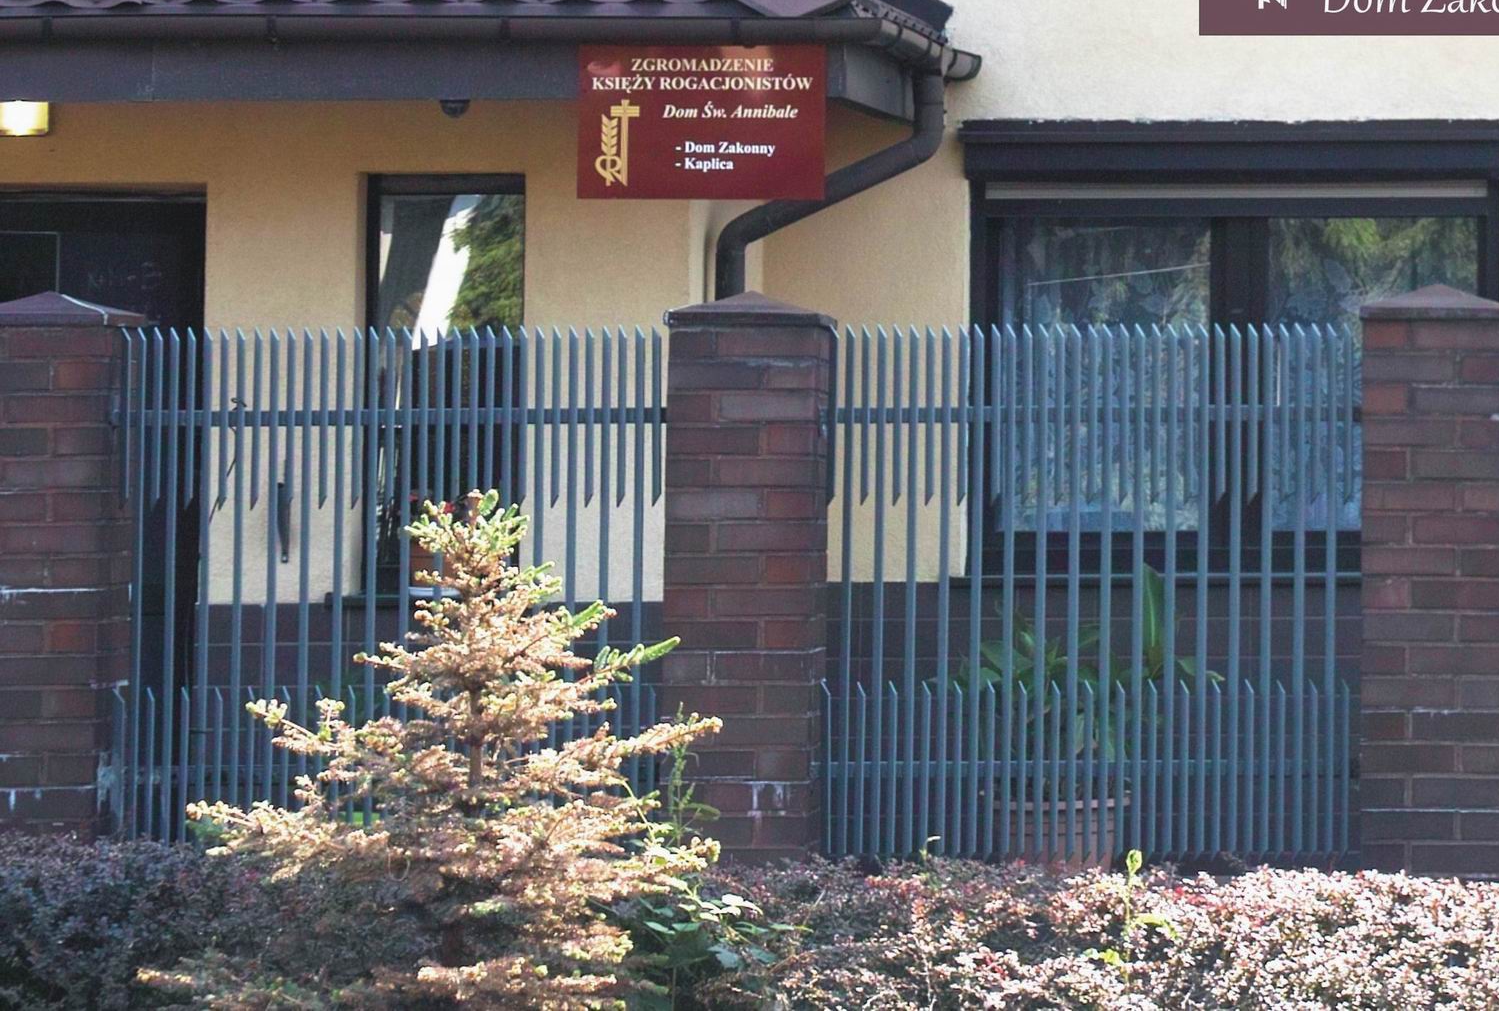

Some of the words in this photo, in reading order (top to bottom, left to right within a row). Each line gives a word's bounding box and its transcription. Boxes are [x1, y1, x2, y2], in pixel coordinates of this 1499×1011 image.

[631, 58, 774, 72] ZGROMADZENIE
[592, 75, 655, 93] KSIĘŻY
[659, 74, 813, 91] ROGACJONISTÓW
[662, 104, 698, 119] Dom
[702, 101, 727, 119] Św.
[731, 104, 799, 119] Annibale
[684, 141, 715, 154] Dom
[718, 141, 776, 157] Zakonny
[684, 157, 734, 173] Kaplica
